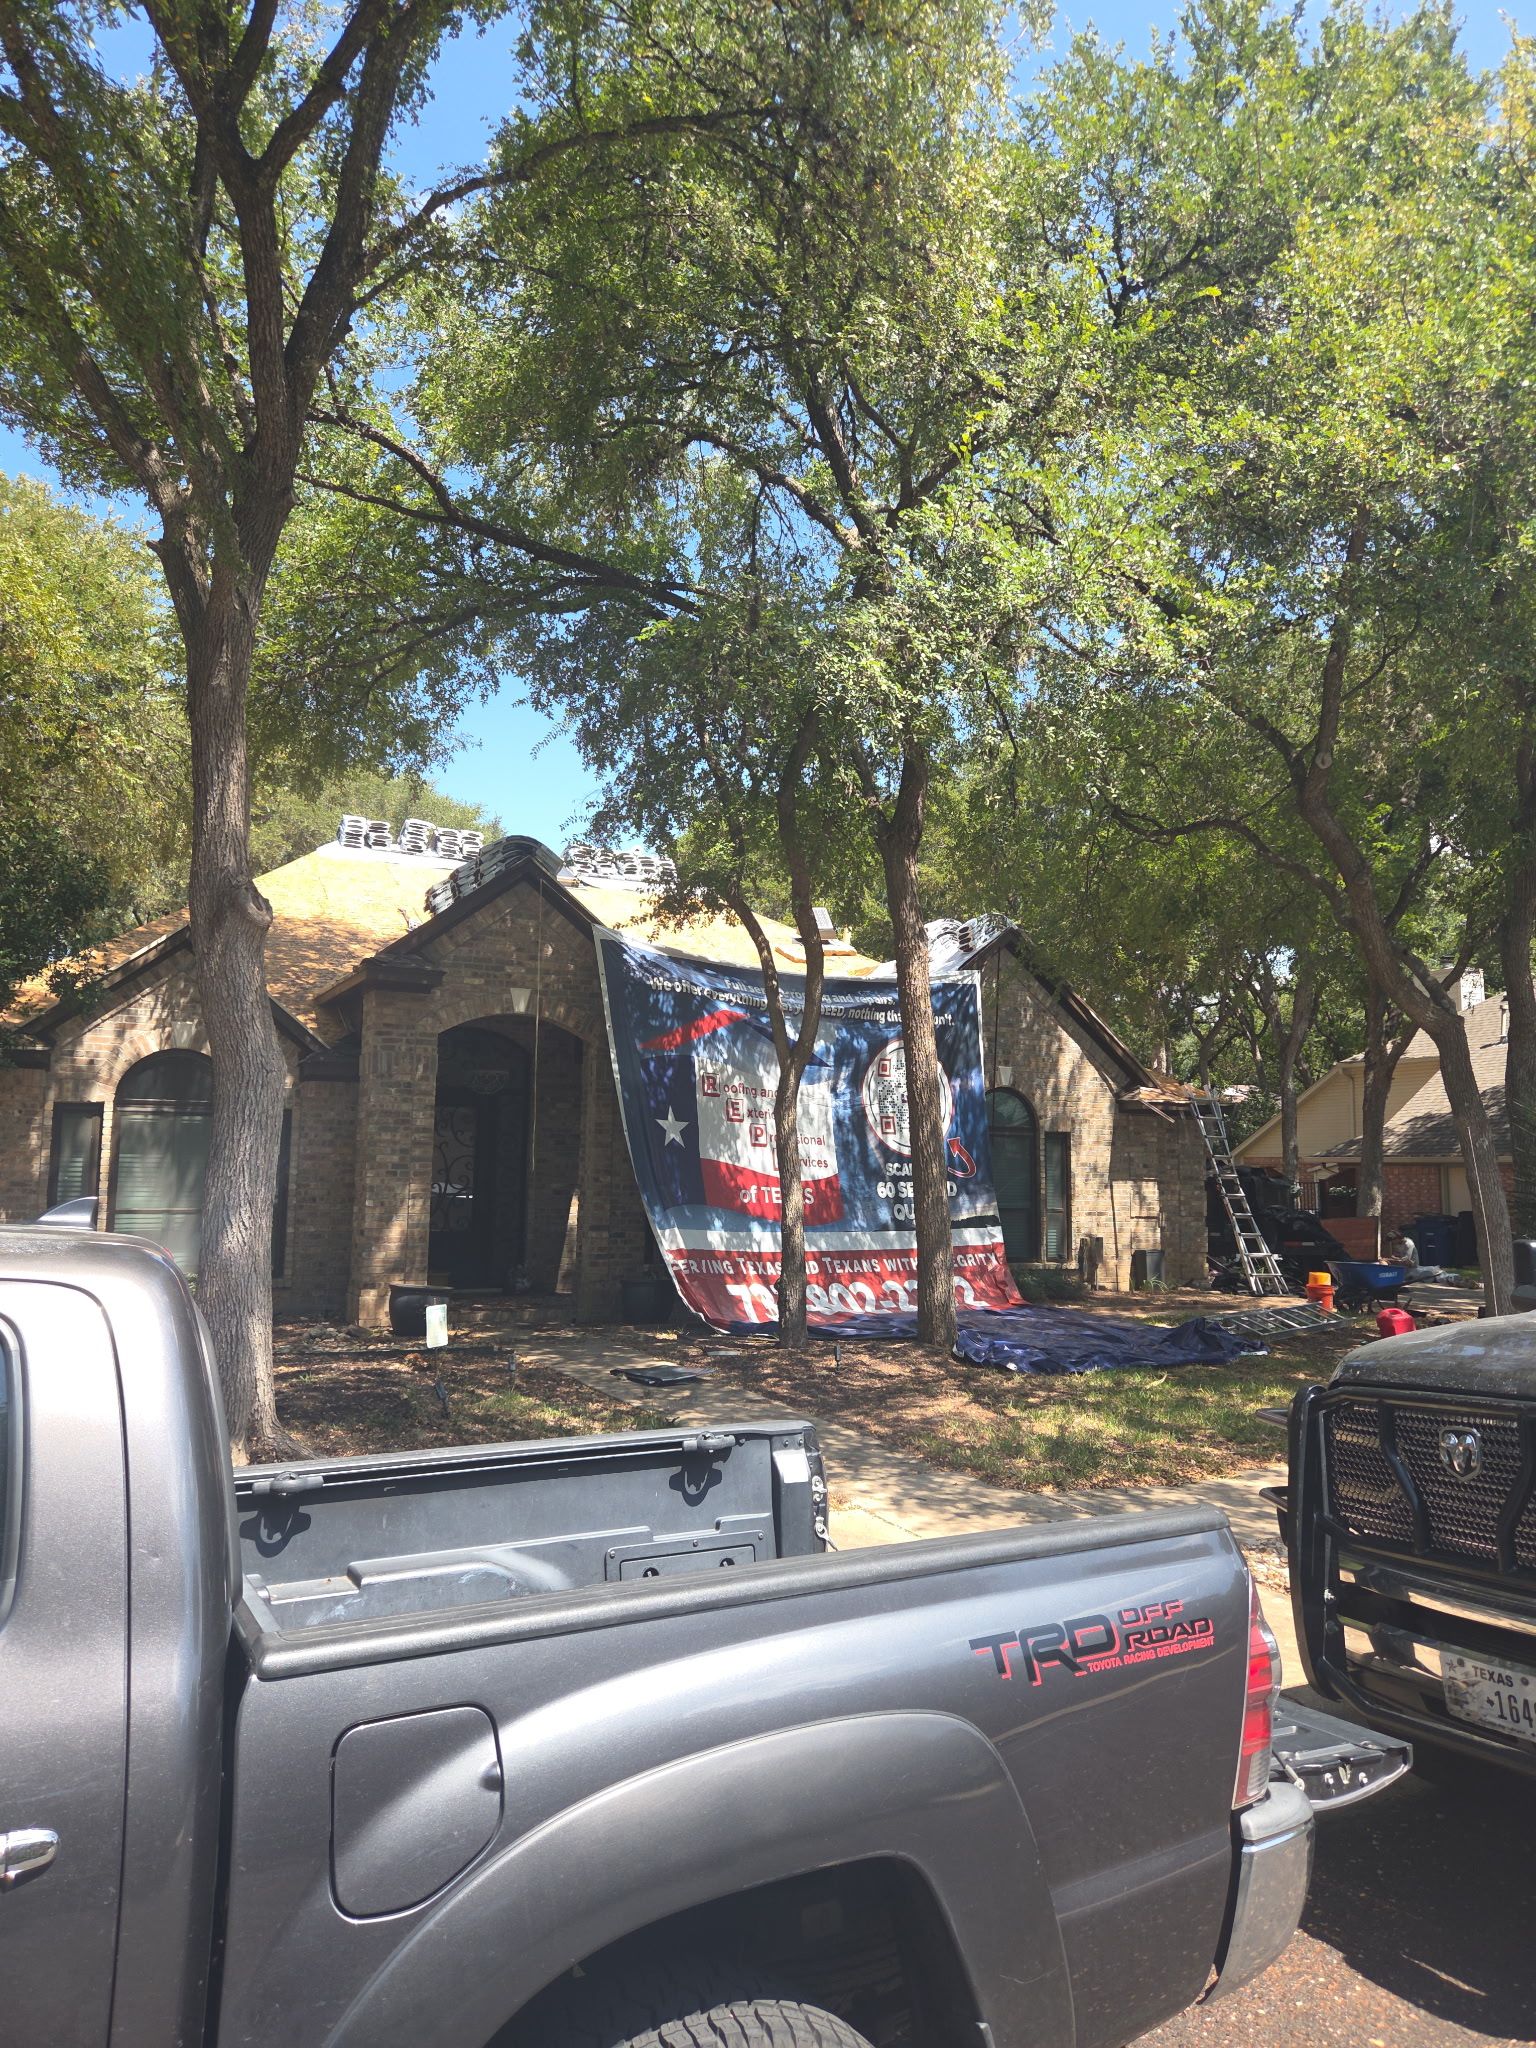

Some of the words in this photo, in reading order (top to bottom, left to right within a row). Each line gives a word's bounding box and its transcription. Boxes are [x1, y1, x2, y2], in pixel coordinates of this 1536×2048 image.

[849, 1007, 886, 1024] nothing
[887, 1009, 903, 1023] tha
[934, 1013, 956, 1026] on't.
[885, 1162, 913, 1177] SCA
[740, 1185, 758, 1204] of
[761, 1186, 815, 1205] TES
[876, 1181, 896, 1199] 60
[805, 1260, 820, 1275] ND
[1117, 1599, 1185, 1629] OFF
[968, 1613, 1121, 1687] TRD
[1124, 1617, 1215, 1653] ROAD
[1087, 1656, 1123, 1673] TOYOTA
[1123, 1649, 1156, 1665] RACING
[1156, 1635, 1216, 1657] DEVELOPMENT
[1471, 1665, 1514, 1688] TEXAS
[1494, 1690, 1536, 1729] 164
